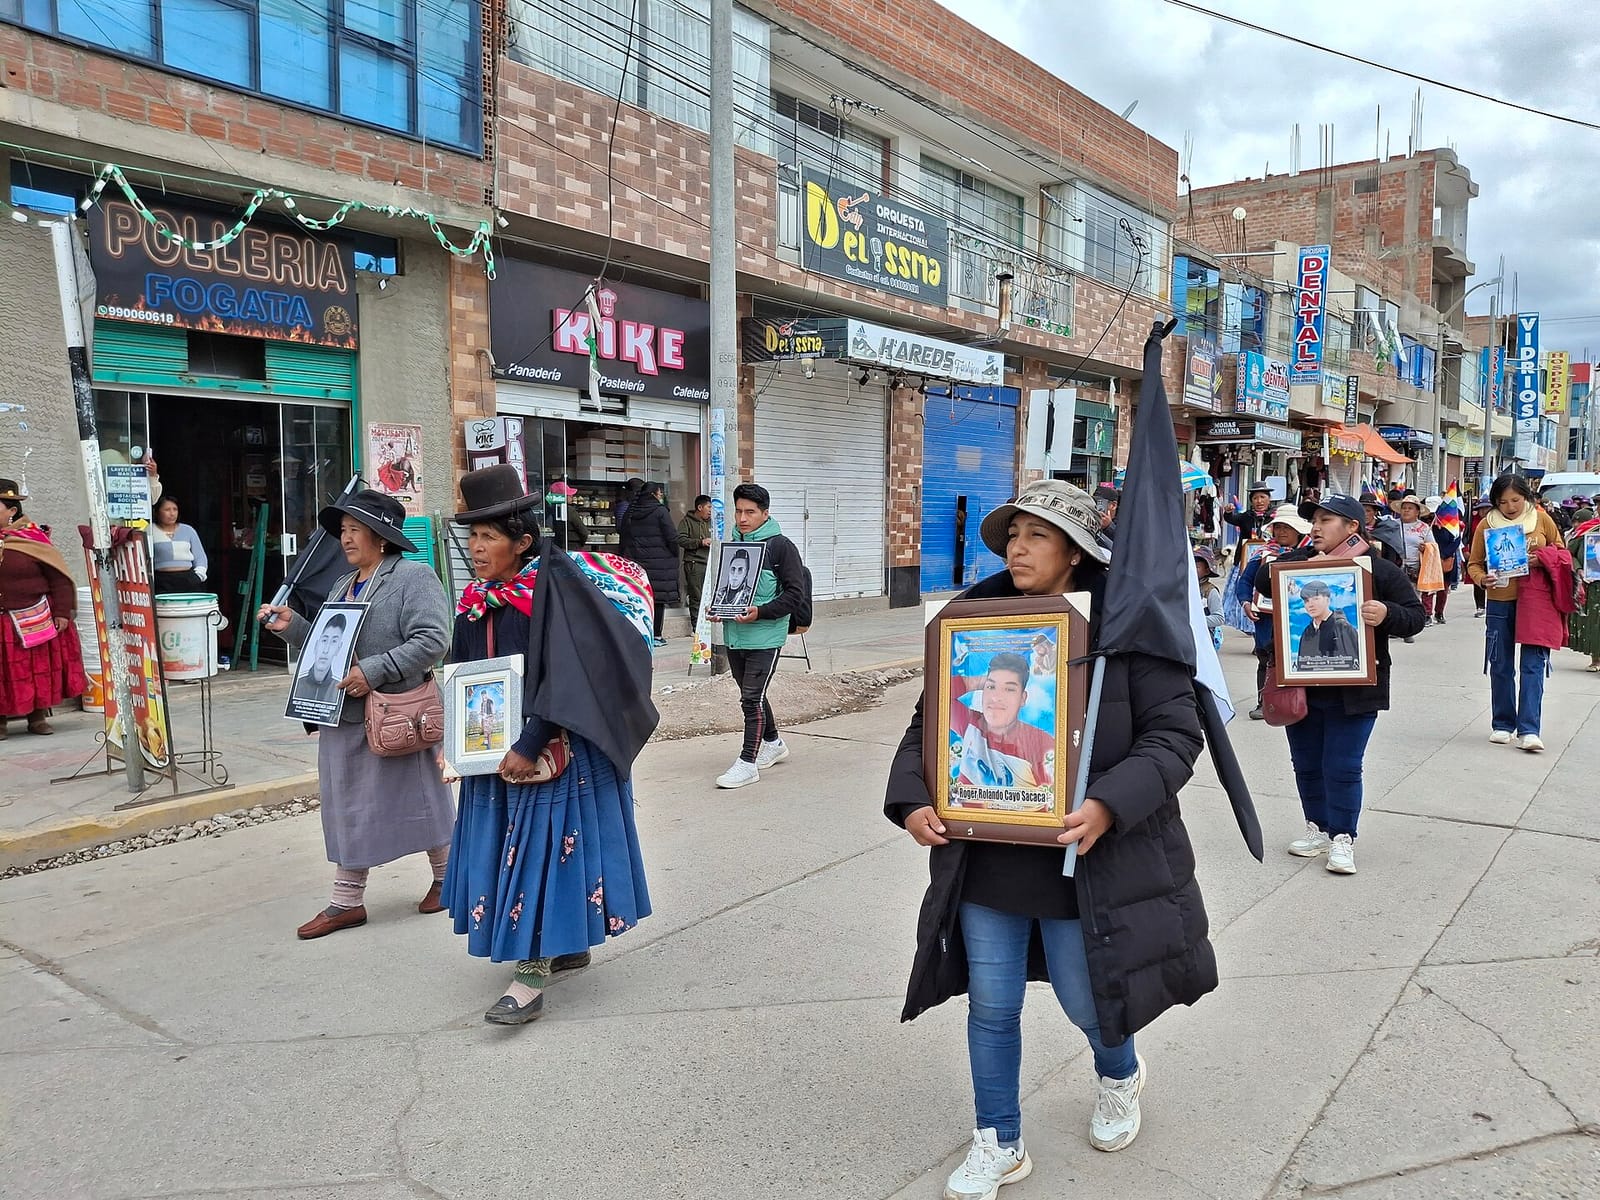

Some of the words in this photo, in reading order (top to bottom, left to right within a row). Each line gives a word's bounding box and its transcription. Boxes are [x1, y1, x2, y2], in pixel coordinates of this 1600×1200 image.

[876, 204, 926, 233] ORQUESTA
[104, 201, 349, 296] POLLERIA
[145, 272, 314, 328] FOGATA
[1297, 257, 1323, 361] DENTAL
[108, 306, 174, 324] 990060618
[508, 363, 562, 381] Panadería
[1518, 317, 1537, 418] VIDRIOS
[1549, 352, 1563, 408] HOSPEDAJE
[599, 375, 646, 392] Pastelería
[673, 385, 710, 400] Cafetería
[1346, 376, 1358, 418] HOSPEDAJE
[475, 433, 494, 445] KIKE
[959, 787, 978, 800] Roger
[978, 788, 1004, 801] Rolando
[1004, 789, 1021, 803] Cayo
[1021, 790, 1046, 803] Sacaca
